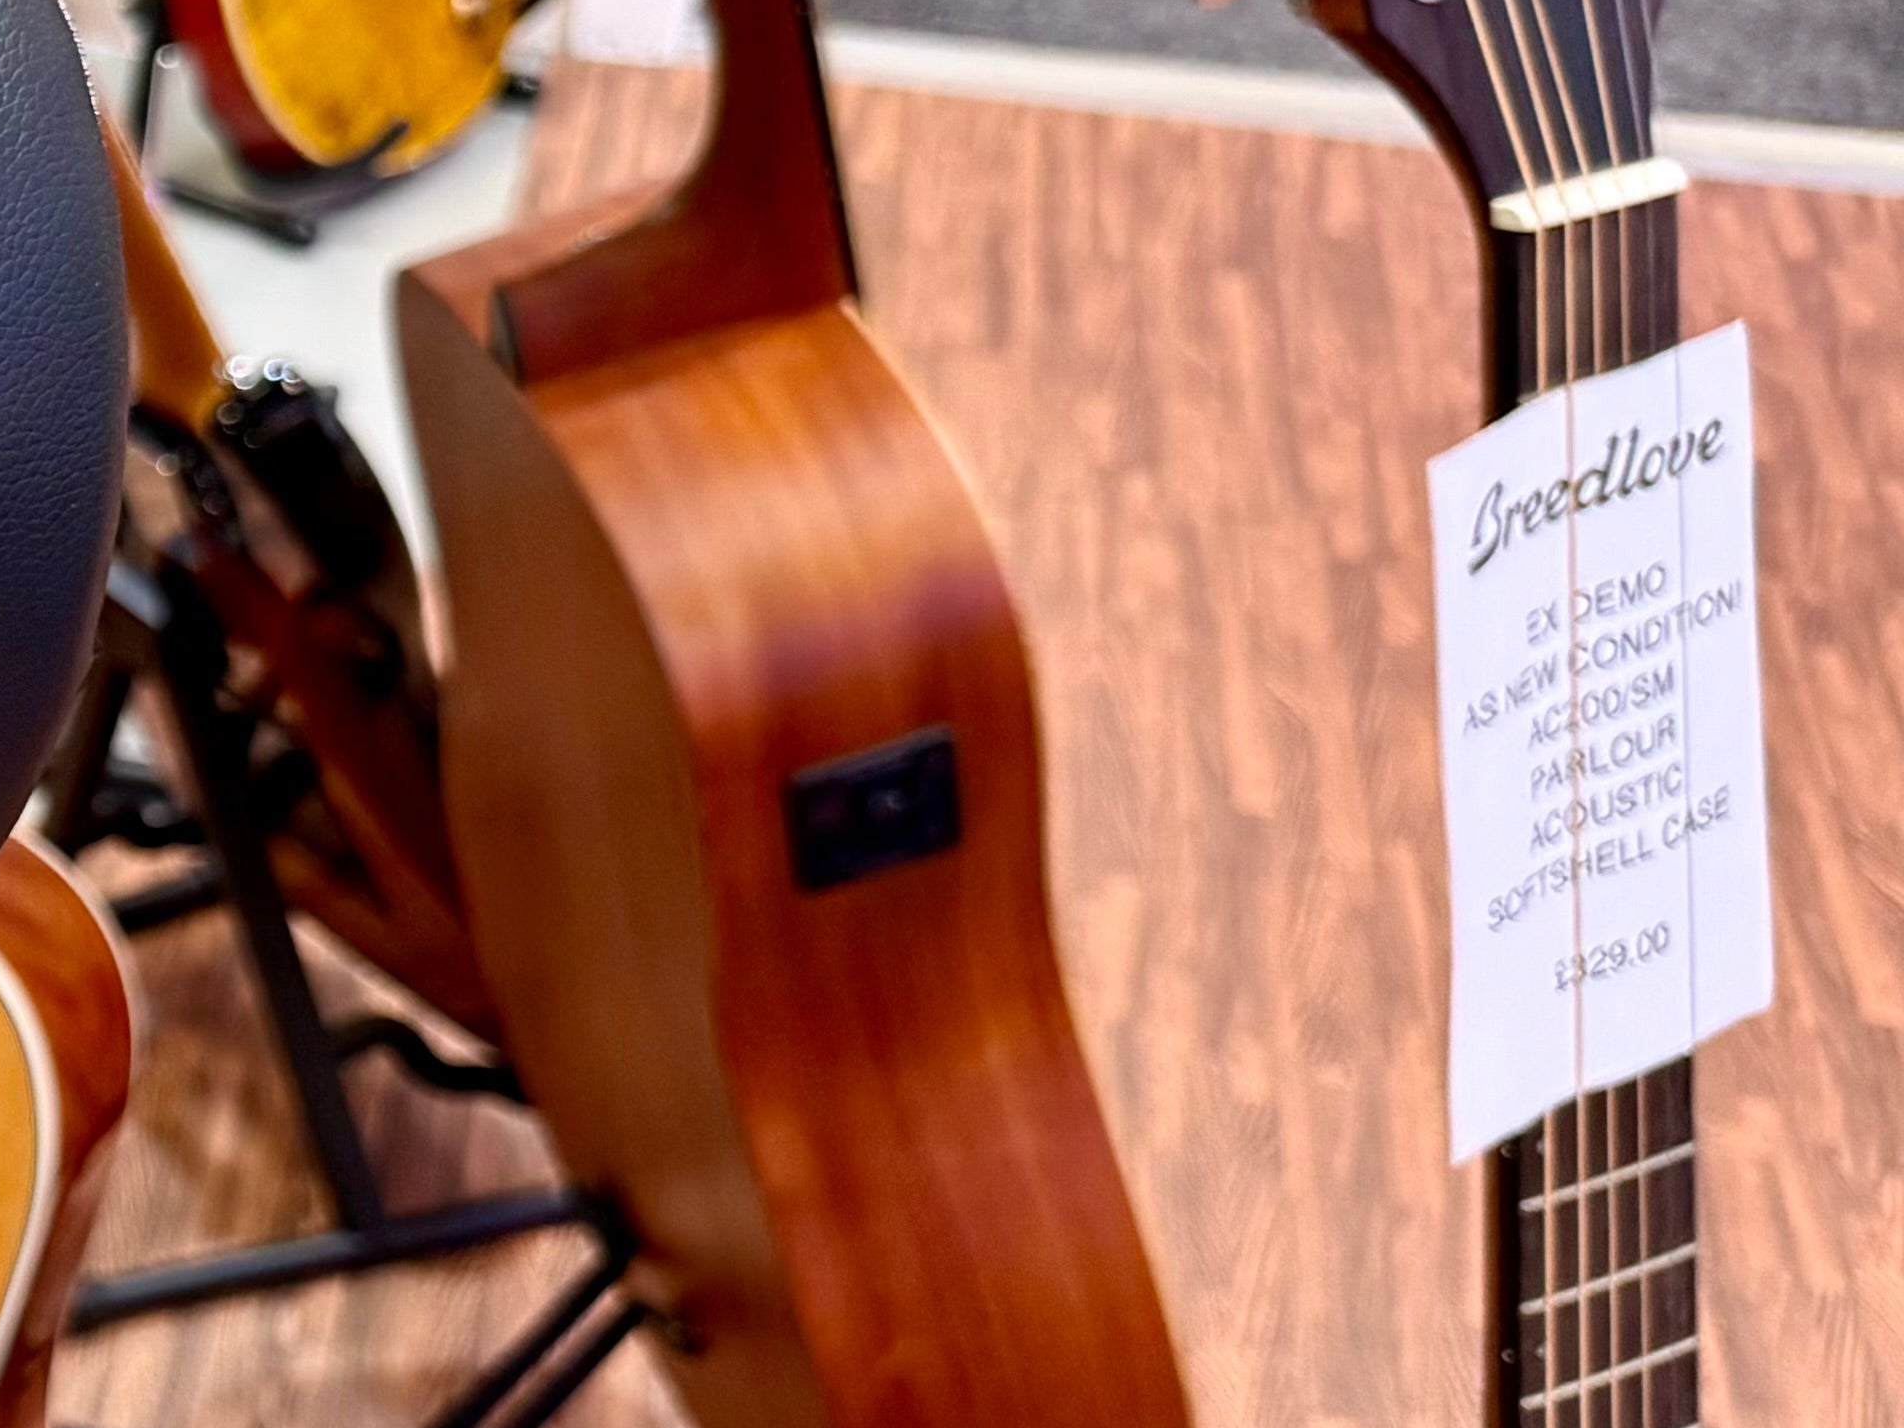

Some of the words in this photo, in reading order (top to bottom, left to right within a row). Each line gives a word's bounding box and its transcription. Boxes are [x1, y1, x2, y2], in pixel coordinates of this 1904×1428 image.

[1468, 417, 1726, 576] Breedlove
[1525, 601, 1560, 646] EX
[1570, 561, 1667, 623] DEMO
[1463, 689, 1498, 736] AS
[1504, 652, 1557, 714] NEW
[1530, 712, 1677, 802] PARLOUR
[1530, 762, 1683, 856] ACOUSTIC
[1487, 829, 1654, 933] SOFTSHELL
[1662, 784, 1730, 850] CASE
